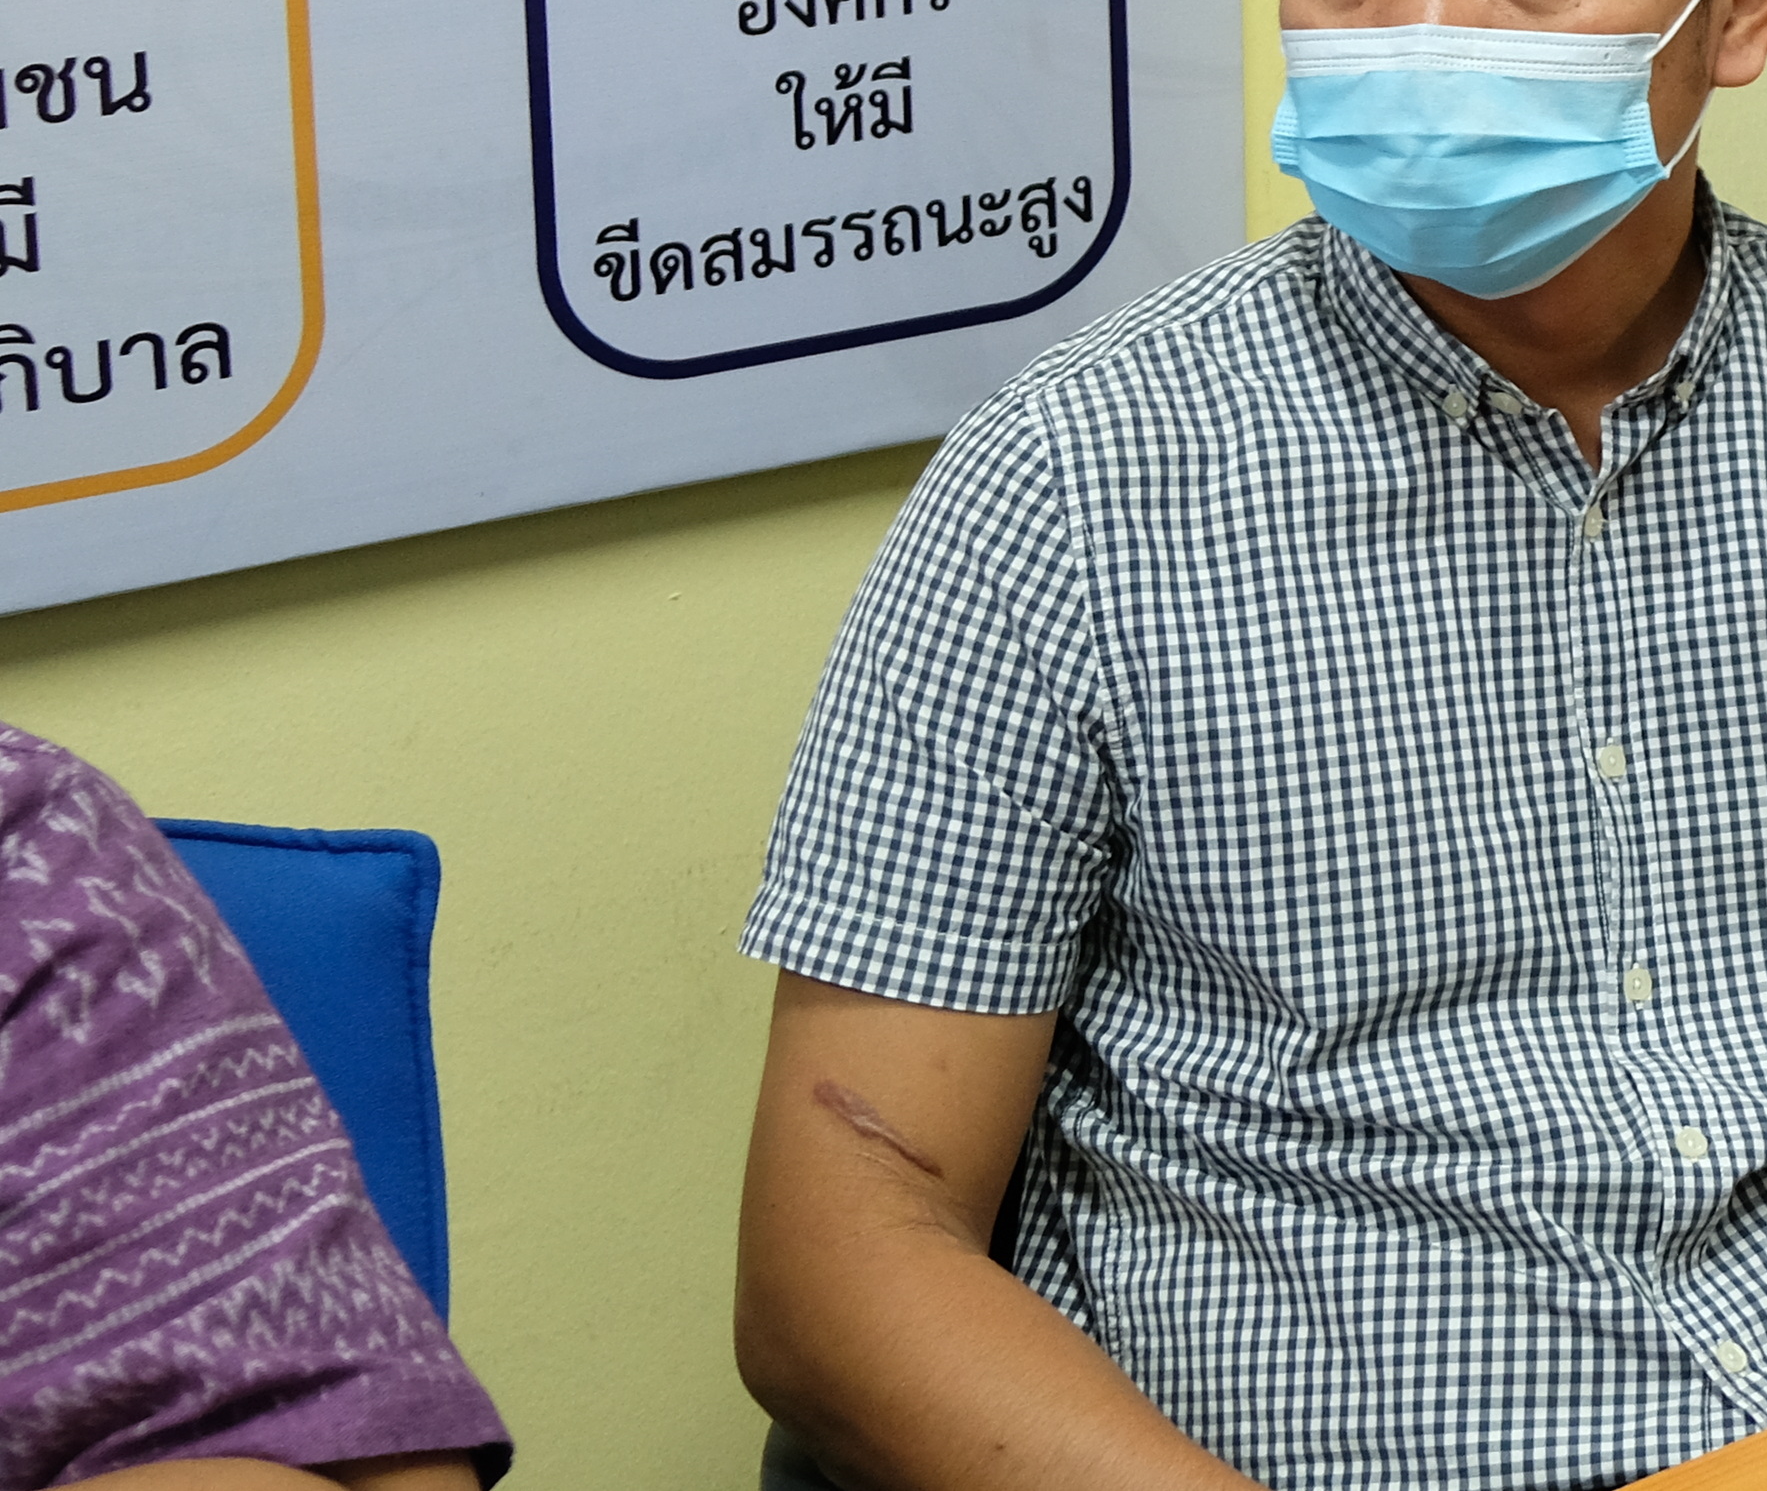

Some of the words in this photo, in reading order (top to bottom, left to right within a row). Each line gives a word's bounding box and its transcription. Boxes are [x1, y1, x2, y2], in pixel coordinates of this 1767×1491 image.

[0, 50, 153, 129] ชน
[776, 58, 915, 152] ให้มี
[593, 168, 1096, 301] ขีดสมรรถนะสูง
